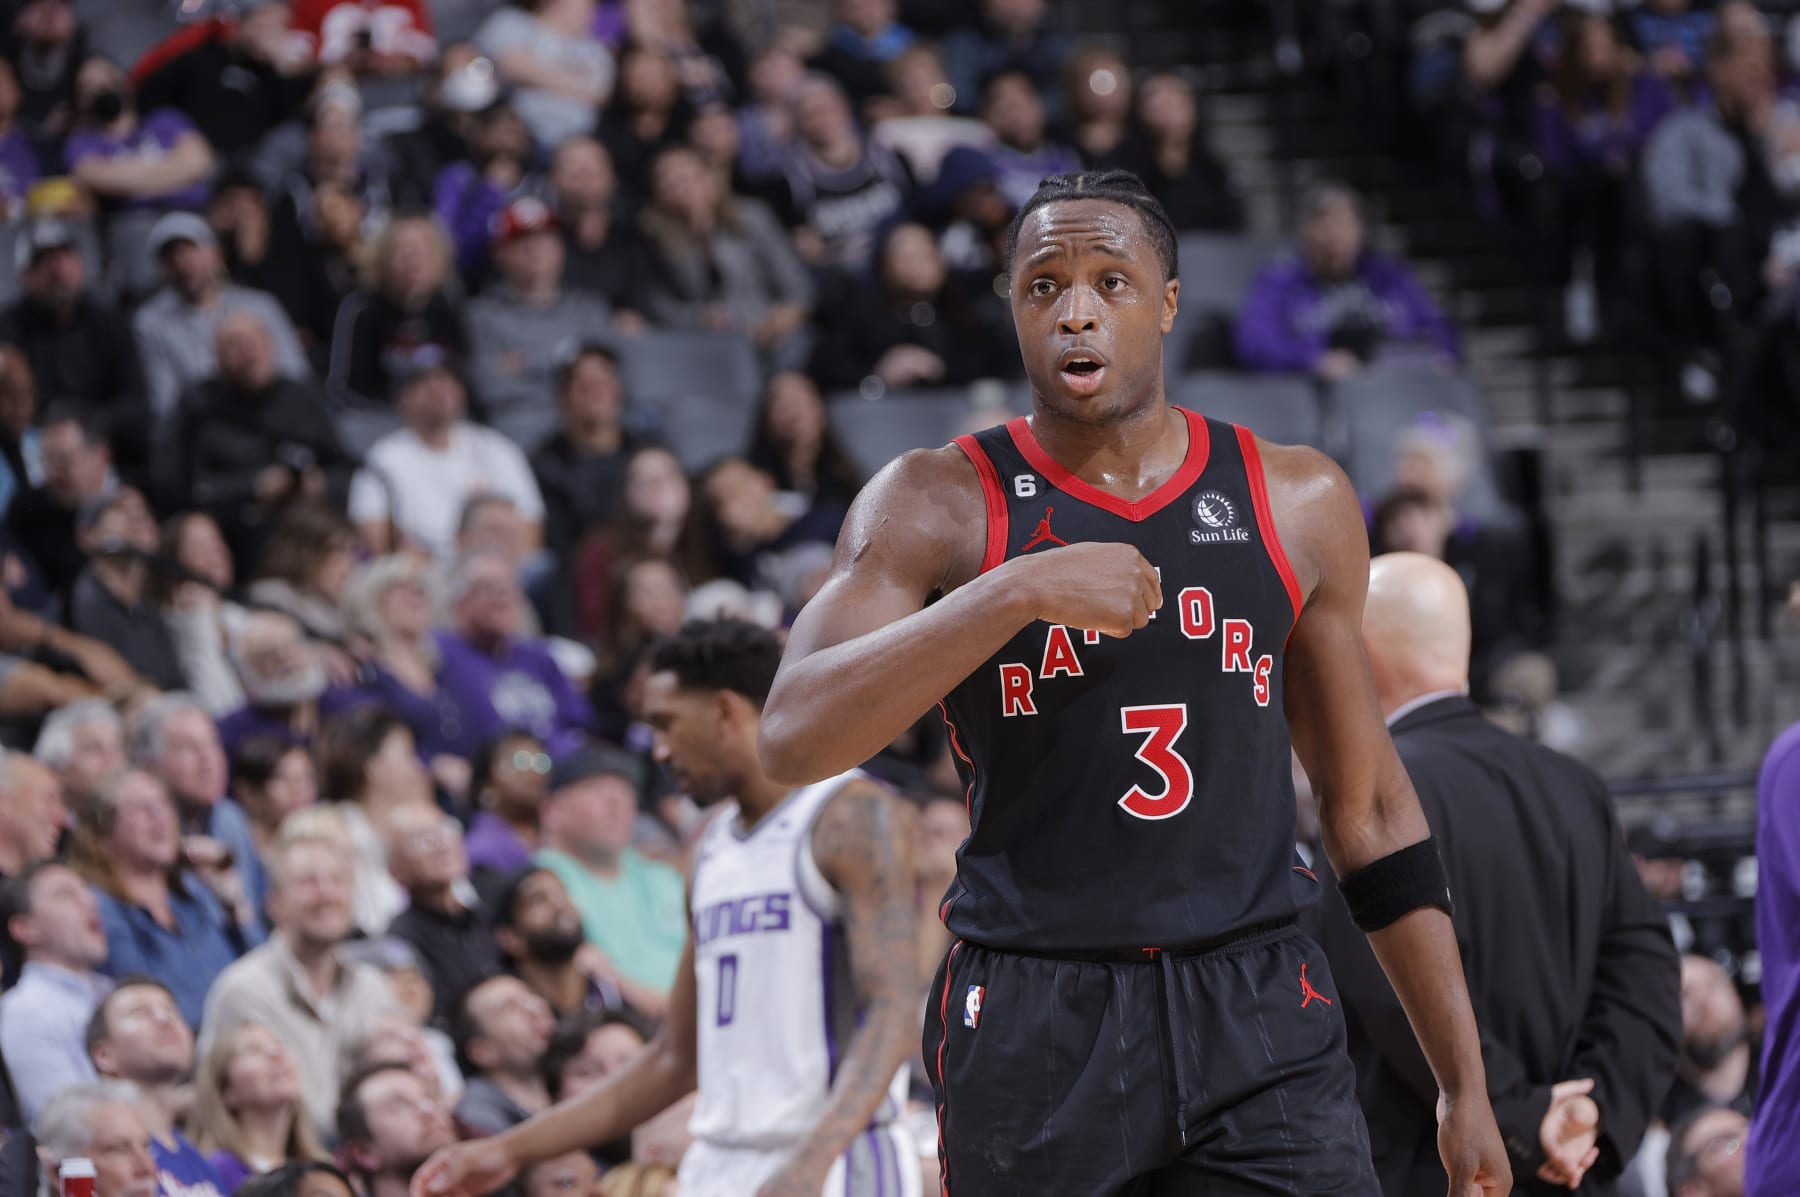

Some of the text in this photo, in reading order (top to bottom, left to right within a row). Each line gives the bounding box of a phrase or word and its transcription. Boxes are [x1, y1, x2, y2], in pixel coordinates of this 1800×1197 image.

[1014, 474, 1036, 497] 6
[1191, 528, 1249, 543] Sun Life
[999, 567, 1272, 717] RAORS
[1117, 703, 1193, 820] 3
[717, 955, 738, 1027] 0
